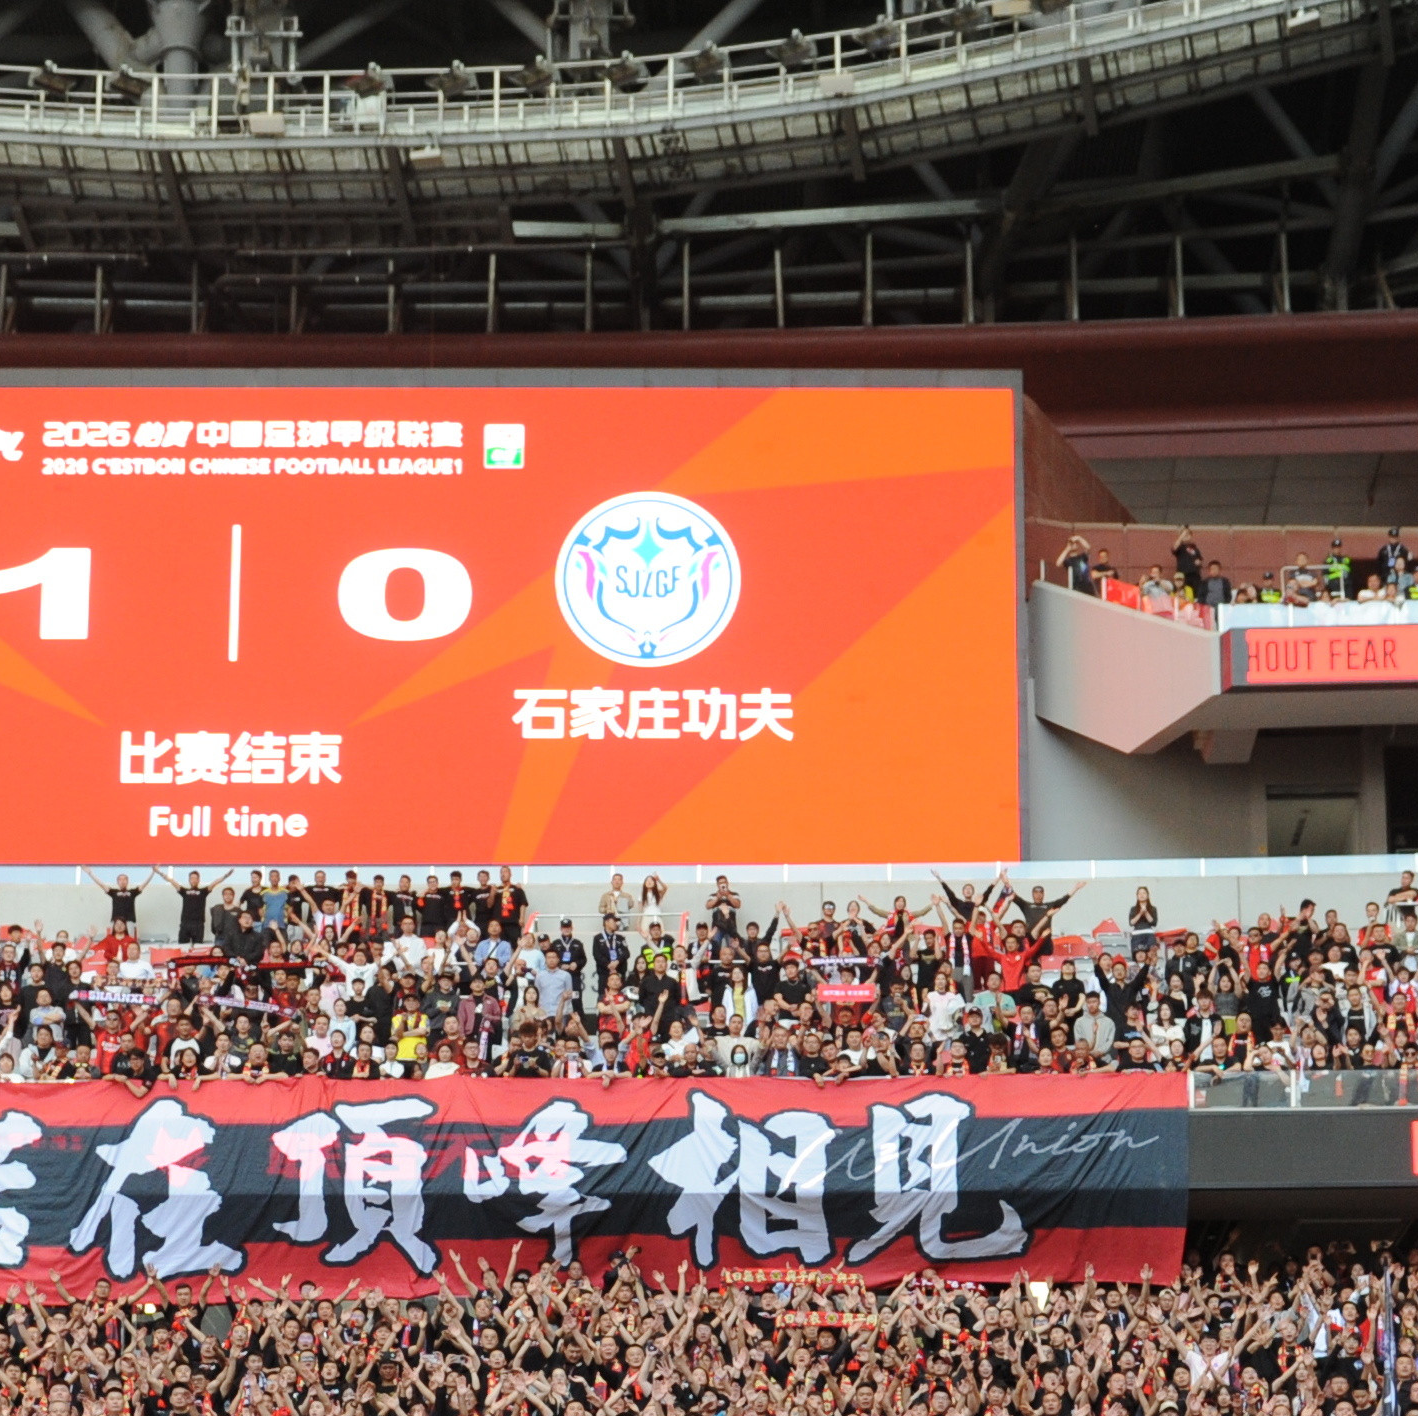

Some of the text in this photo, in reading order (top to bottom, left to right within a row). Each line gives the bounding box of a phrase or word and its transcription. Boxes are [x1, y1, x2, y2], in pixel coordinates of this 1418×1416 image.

[43, 421, 130, 447] 2026
[42, 458, 88, 474] 2026
[190, 457, 271, 475] CHINESE
[275, 457, 374, 475] FOOTBALL
[337, 547, 473, 642] 0
[615, 564, 681, 598] SJZGF
[1329, 639, 1398, 671] FEAR
[512, 686, 794, 741] 石家庄功夫
[119, 729, 342, 786] 比赛结束
[149, 804, 309, 838] Full time
